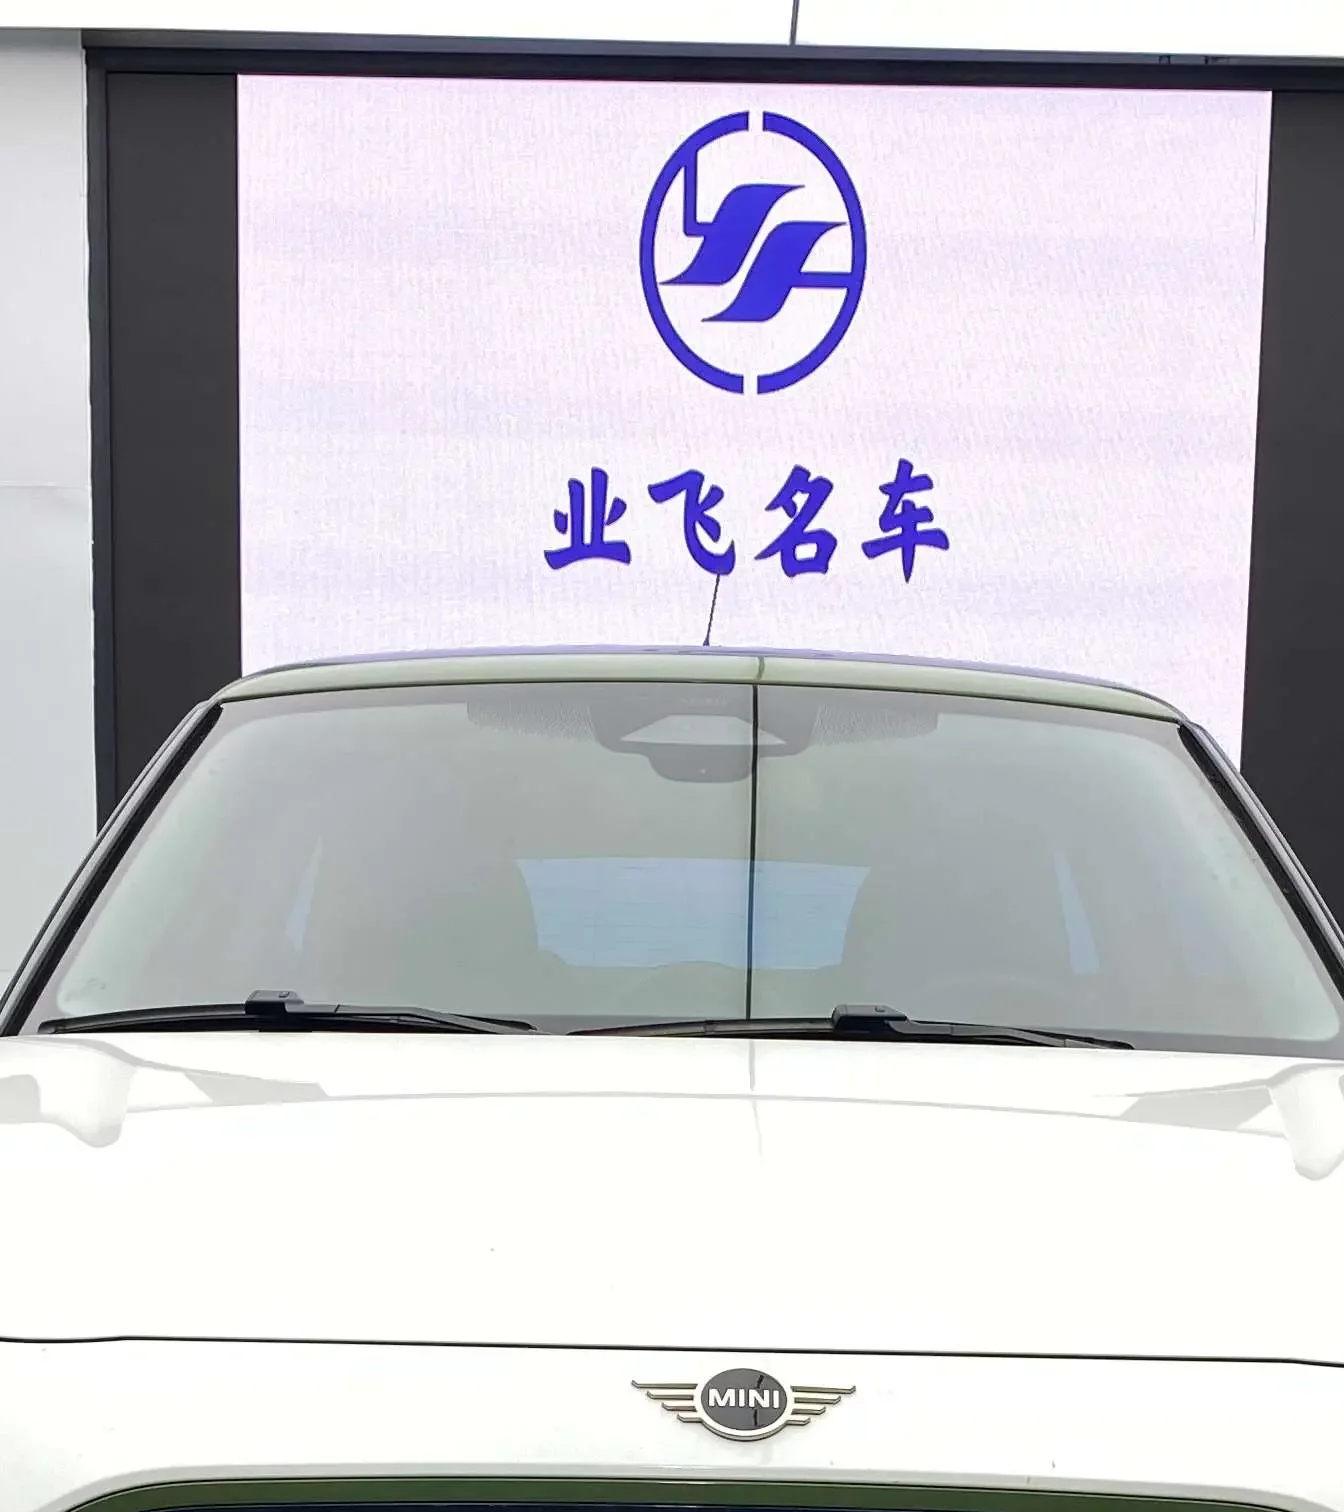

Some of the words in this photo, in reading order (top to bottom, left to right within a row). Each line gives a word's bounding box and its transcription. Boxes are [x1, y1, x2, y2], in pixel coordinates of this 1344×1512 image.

[544, 458, 950, 582] 业飞名车
[708, 1388, 780, 1409] MINI
